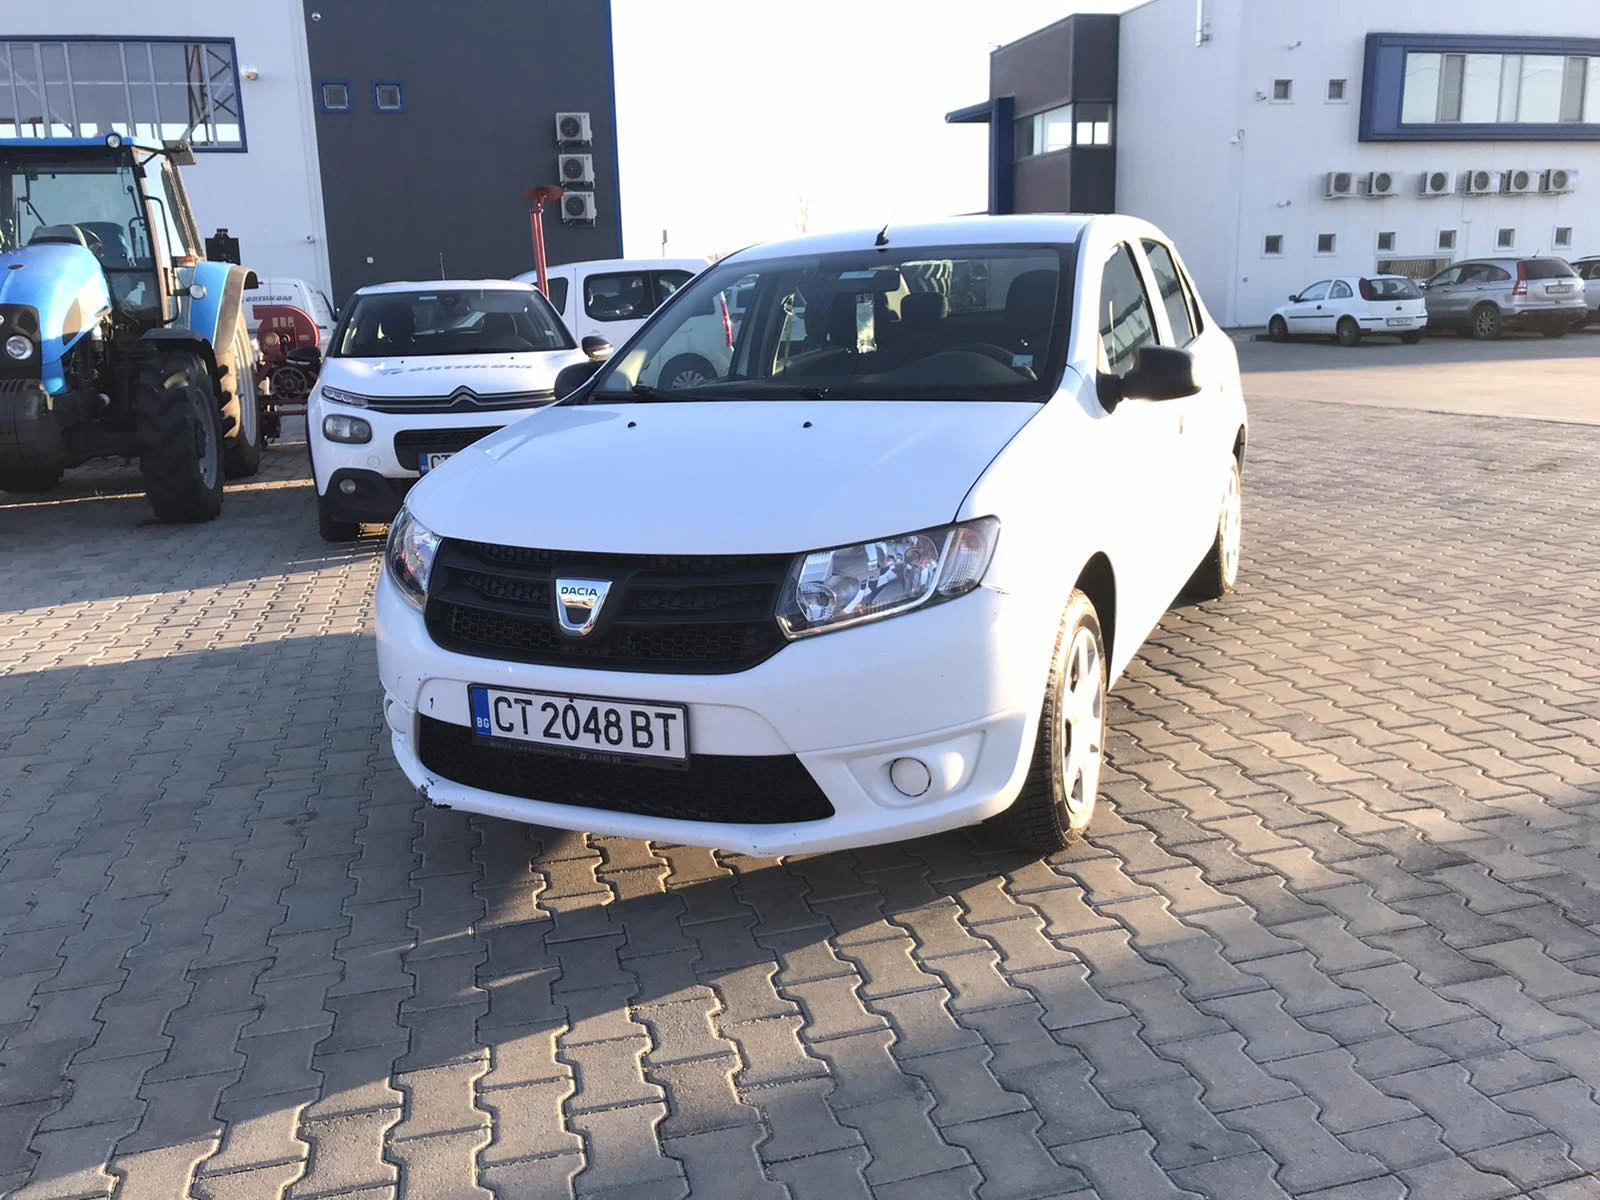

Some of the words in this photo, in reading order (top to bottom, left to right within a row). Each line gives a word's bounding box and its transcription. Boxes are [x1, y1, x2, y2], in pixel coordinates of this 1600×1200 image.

[561, 586, 598, 597] DACIA
[476, 716, 490, 729] BG
[493, 696, 533, 735] CT
[540, 701, 624, 746] 2048
[630, 709, 677, 751] BT
